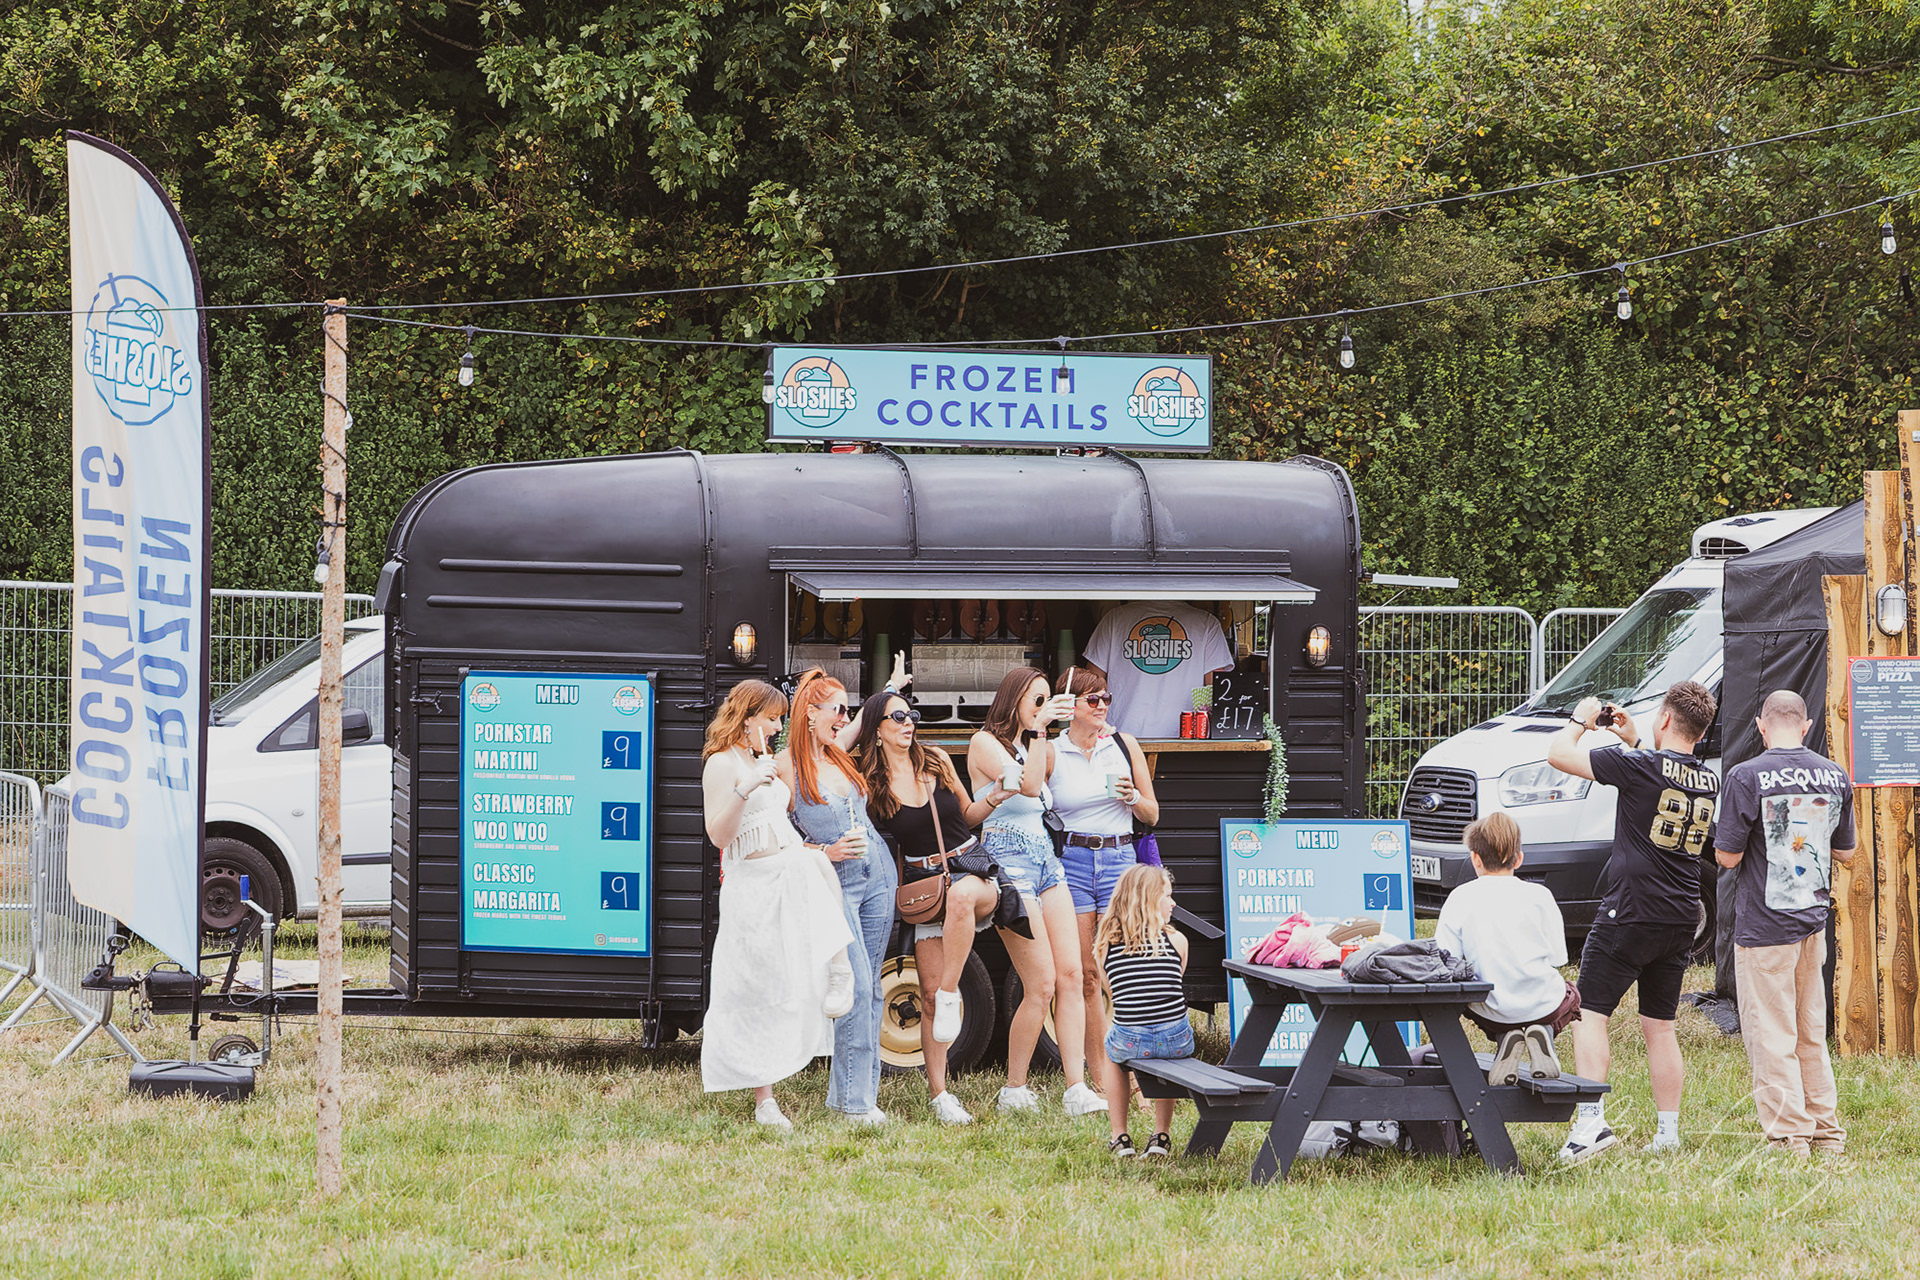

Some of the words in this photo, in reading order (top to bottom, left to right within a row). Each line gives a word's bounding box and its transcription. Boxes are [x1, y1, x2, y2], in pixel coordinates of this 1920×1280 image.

[911, 364, 1075, 394] FROZEN
[776, 386, 857, 410] SLOSHIES
[1127, 395, 1206, 420] SLOSHIES
[877, 399, 1108, 431] COCKTAILS
[1123, 639, 1192, 660] SLOSHIES
[1877, 671, 1913, 682] PIZZA
[536, 685, 579, 704] MENU
[1218, 678, 1233, 700] 2
[1238, 694, 1253, 704] for
[1216, 706, 1255, 730] £17
[473, 722, 553, 743] PORNSTAR
[473, 750, 538, 770] MARTINI
[473, 793, 574, 815] STRAWBERRY
[473, 820, 507, 841] WOO
[513, 822, 548, 842] WOO
[1648, 788, 1715, 856] 88
[1296, 830, 1339, 849] MENU
[473, 863, 536, 884] CLASSIC
[1411, 858, 1421, 875] 65
[1237, 868, 1315, 888] PORNSTAR
[473, 889, 562, 912] MARGARITA
[1238, 894, 1302, 914] MARTINI
